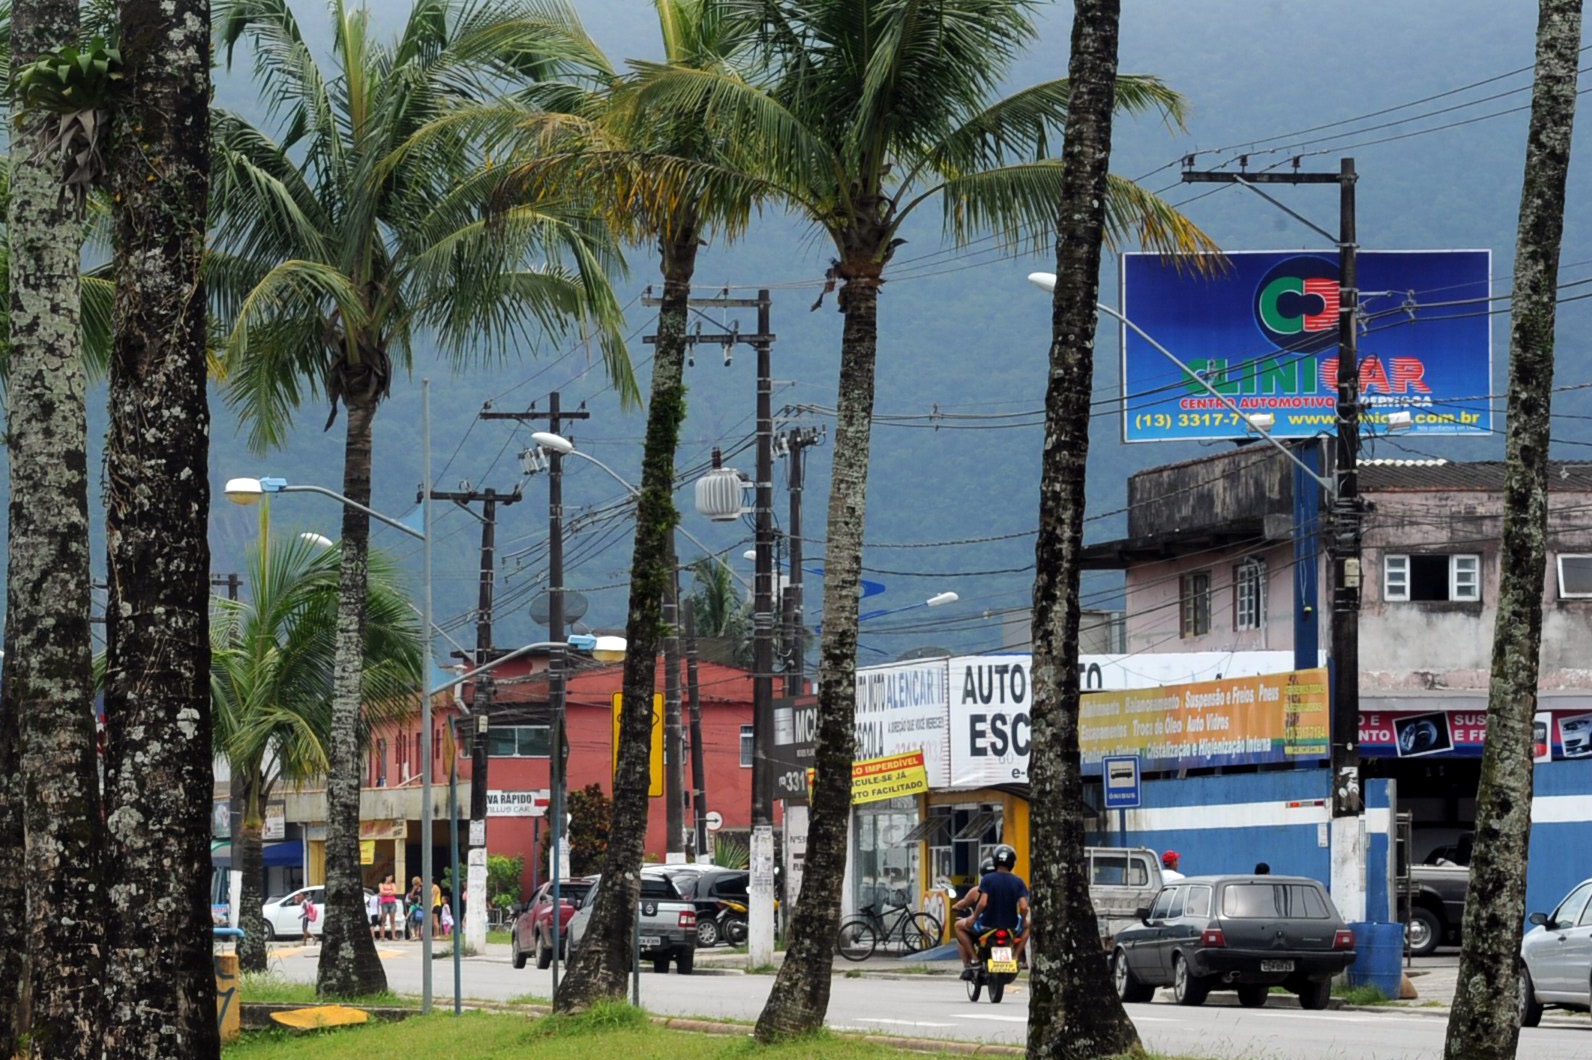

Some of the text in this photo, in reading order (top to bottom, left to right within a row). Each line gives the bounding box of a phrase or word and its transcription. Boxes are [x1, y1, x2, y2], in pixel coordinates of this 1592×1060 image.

[1182, 356, 1433, 396] CLINICAR
[1179, 396, 1337, 410] CENTRO AUTOMOTIVO
[1135, 414, 1172, 430] (13)
[887, 669, 934, 708] ALENCAR
[962, 664, 1026, 704] AUTO
[1185, 688, 1225, 712] Suspensão
[1232, 685, 1255, 704] Freios
[1258, 684, 1280, 702] Pneus
[1133, 719, 1153, 737] Troca
[1187, 715, 1204, 732] Auto
[1206, 713, 1230, 731] Vidros
[1370, 715, 1381, 726] E
[1454, 715, 1488, 726] SUS
[970, 713, 1034, 756] ESC
[1358, 730, 1391, 741] NTO
[1454, 730, 1487, 741] E FR
[1198, 736, 1246, 760] Higienização
[1246, 735, 1272, 753] Interna
[865, 757, 919, 774] IMPERDÍVEL
[851, 774, 893, 788] ICULE-SE
[871, 780, 923, 796] FACILITADO
[487, 793, 532, 804] VA RÁPIDO
